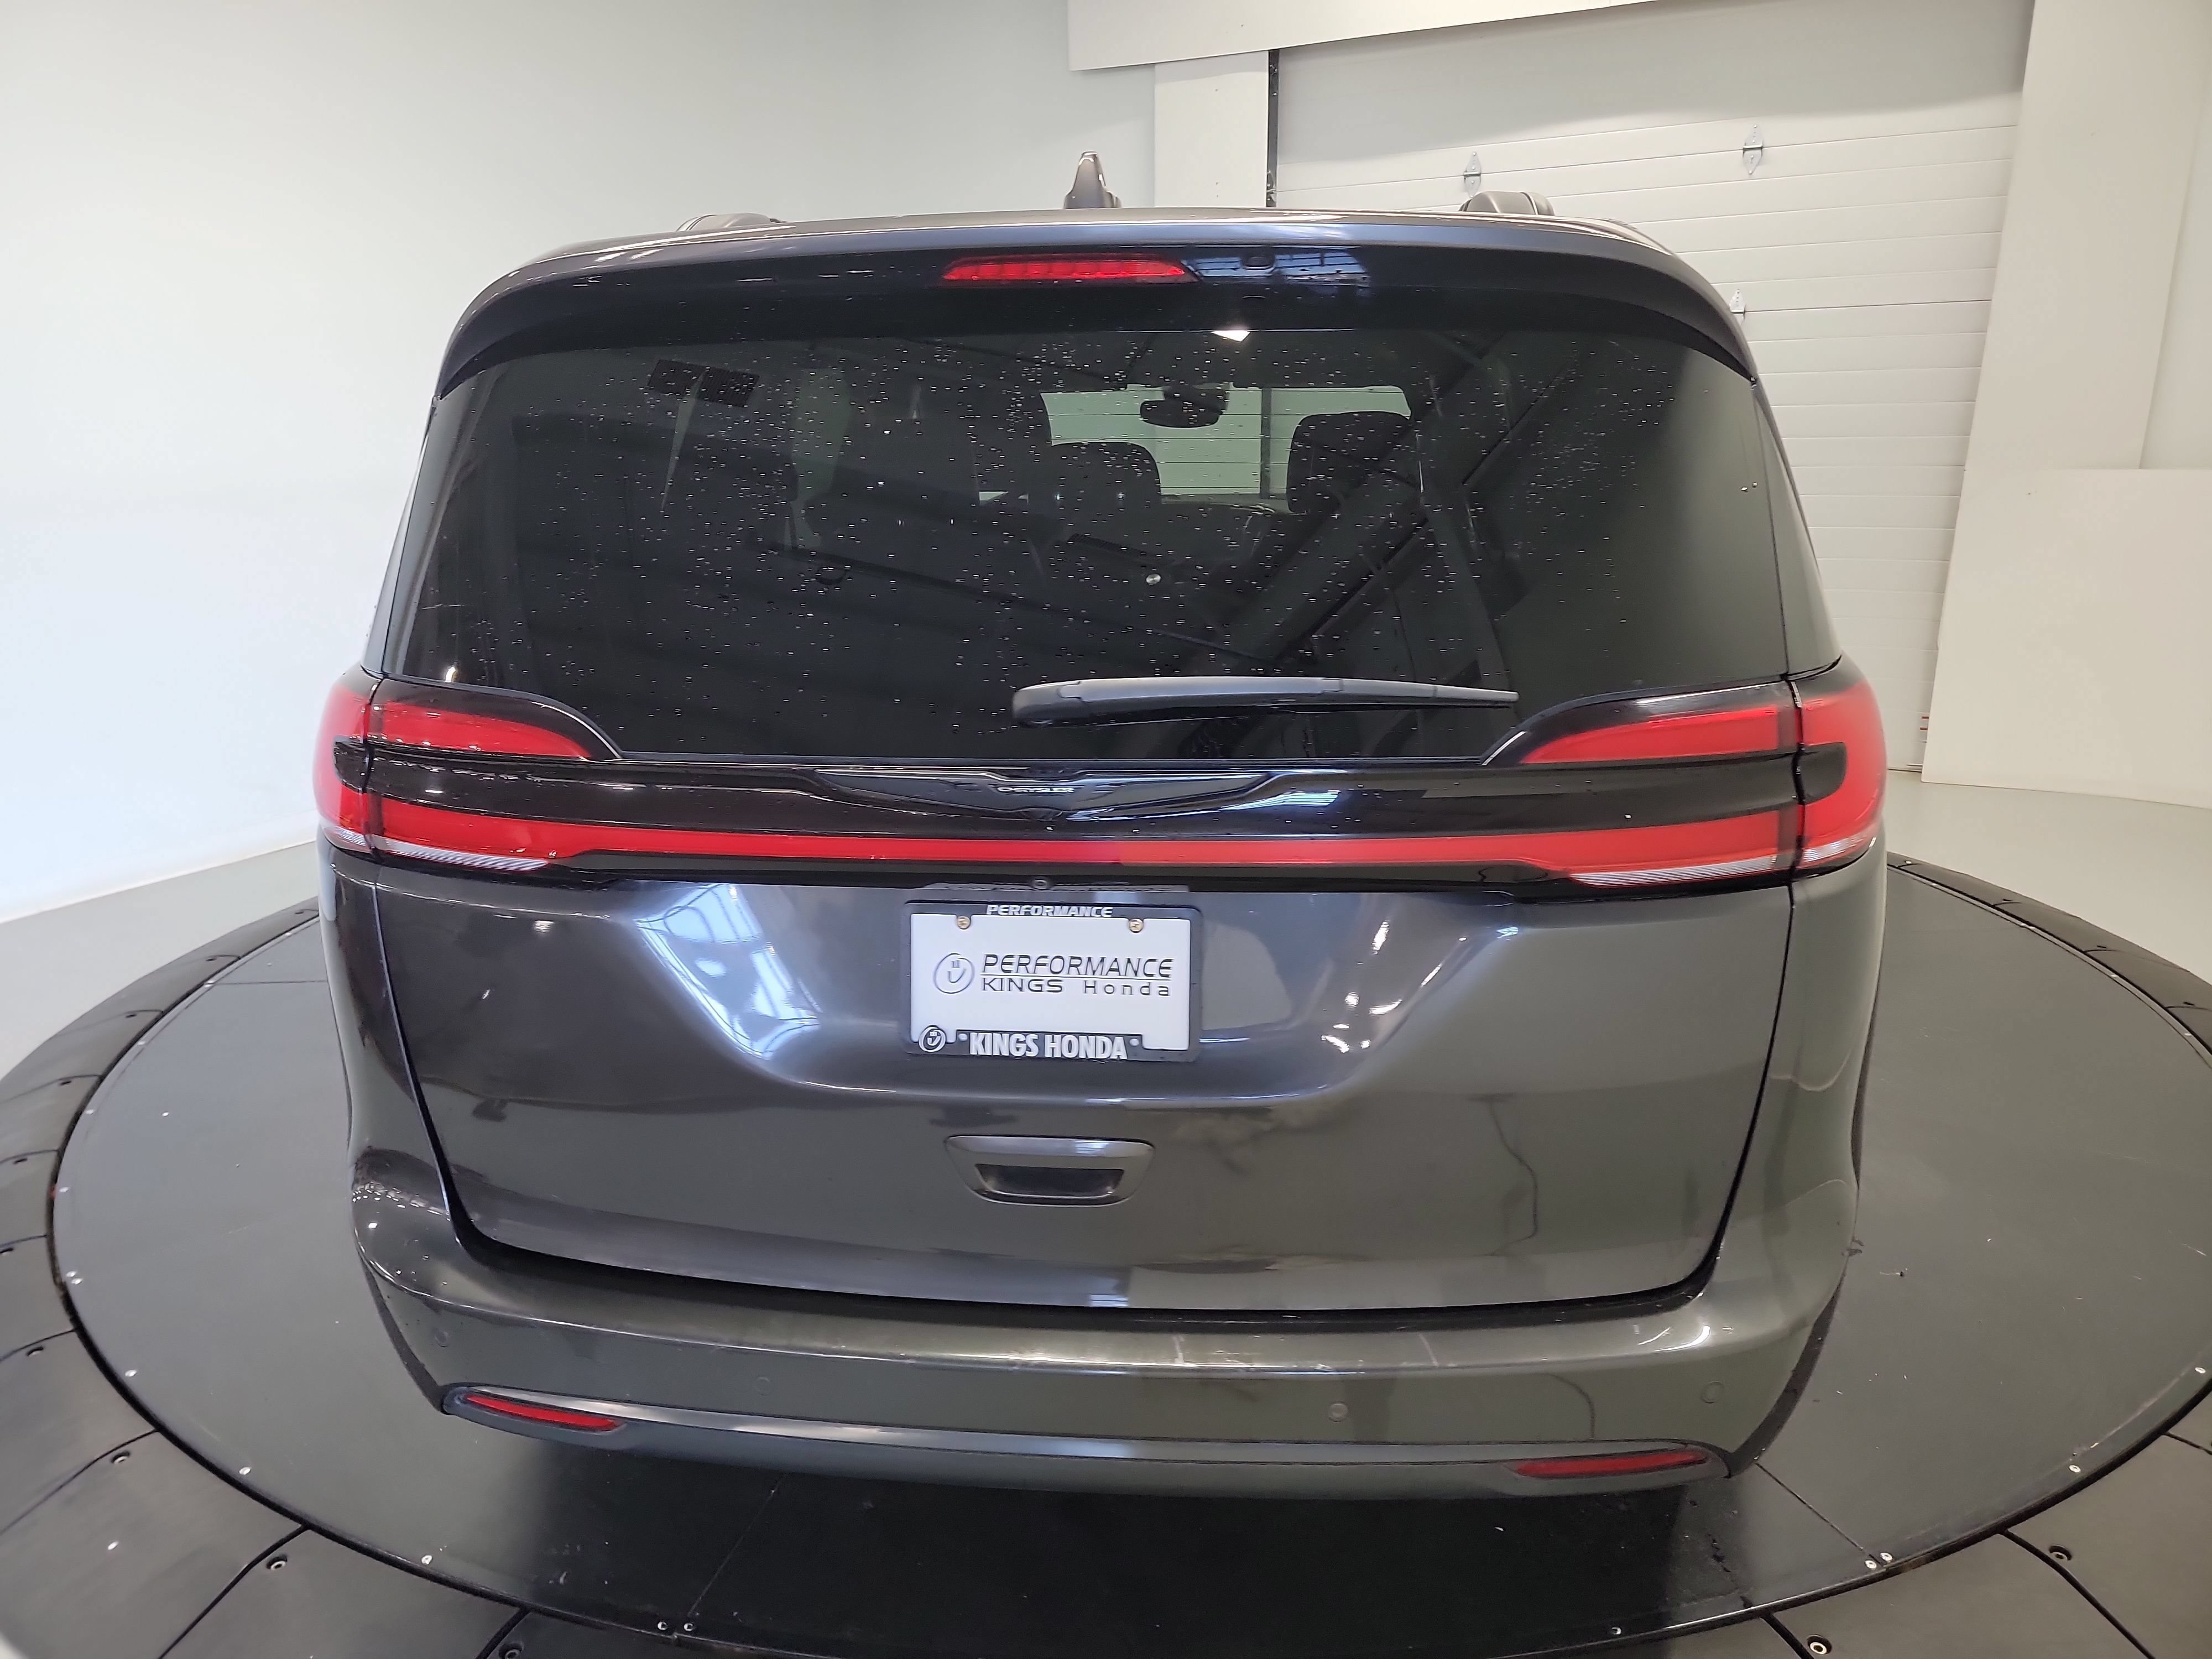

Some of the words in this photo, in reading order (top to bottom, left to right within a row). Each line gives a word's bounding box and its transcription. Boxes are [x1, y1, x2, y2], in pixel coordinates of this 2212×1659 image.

[987, 905, 1113, 917] PERFORMANCE
[983, 954, 1174, 978] PERFORMANCE
[982, 978, 1063, 993] KINGS
[1083, 980, 1170, 997] Honda
[970, 1032, 1039, 1057] KINGS
[1044, 1034, 1128, 1060] HONDA
